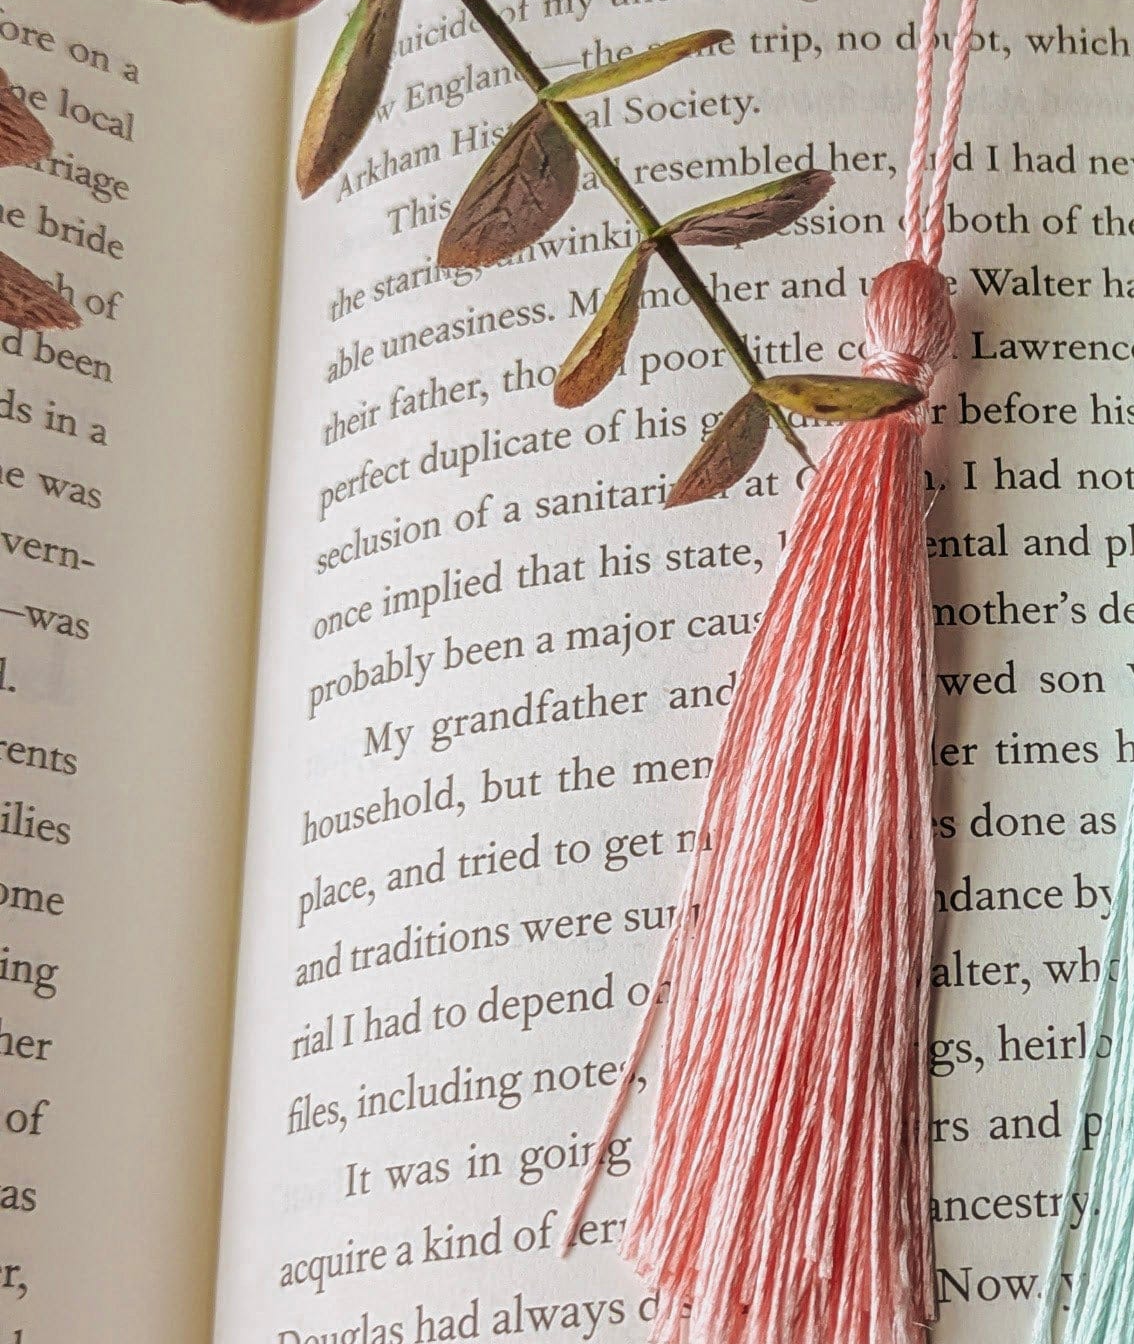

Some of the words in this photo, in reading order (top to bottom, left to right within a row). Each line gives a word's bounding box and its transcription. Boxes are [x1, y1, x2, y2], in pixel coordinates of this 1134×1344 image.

[66, 44, 109, 72] on
[750, 31, 822, 63] trip,
[837, 30, 881, 51] no
[1025, 24, 1131, 57] which
[59, 88, 134, 142] local
[333, 134, 441, 203] Arkham
[622, 88, 760, 125] Society.
[36, 205, 124, 260] bride
[386, 194, 452, 237] This
[634, 142, 816, 185] resembled
[829, 145, 896, 181] her,
[1012, 140, 1077, 174] had
[82, 291, 124, 320] of
[329, 288, 365, 322] the
[946, 202, 1030, 234] both
[1043, 203, 1082, 235] of
[35, 331, 113, 383] been
[326, 340, 374, 384] able
[380, 303, 555, 364] uneasiness.
[780, 265, 847, 300] and
[969, 264, 1092, 297] Walter
[44, 401, 77, 437] in
[323, 401, 381, 446] their
[390, 376, 489, 420] father,
[639, 344, 729, 386] poor
[37, 473, 101, 509] was
[319, 457, 410, 523] perfect
[419, 428, 571, 478] duplicate
[582, 417, 621, 445] of
[635, 407, 687, 440] his
[957, 391, 1077, 427] before
[316, 512, 442, 575] seclusion
[453, 503, 489, 532] of
[745, 467, 779, 497] at
[993, 456, 1062, 490] had
[313, 602, 372, 639] once
[381, 559, 503, 619] implied
[517, 553, 585, 589] that
[599, 543, 651, 578] his
[666, 543, 763, 574] state,
[1024, 523, 1091, 556] and
[308, 644, 436, 720] probably
[441, 636, 525, 670] been
[565, 612, 675, 658] major
[364, 721, 415, 761] My
[431, 683, 648, 753] grandfather
[1040, 671, 1106, 693] son
[303, 773, 465, 846] household,
[480, 768, 542, 803] but
[555, 755, 616, 793] the
[995, 732, 1099, 765] times
[298, 875, 375, 929] place,
[387, 846, 445, 891] and
[457, 832, 541, 878] tried
[554, 840, 591, 865] to
[601, 830, 664, 872] get
[970, 801, 1066, 837] done
[296, 940, 342, 987] and
[350, 921, 510, 972] traditions
[519, 911, 612, 944] were
[292, 1014, 334, 1060] rial
[363, 996, 422, 1043] had
[432, 1003, 467, 1030] to
[477, 971, 615, 1032] depend
[287, 1093, 347, 1135] files,
[357, 1065, 523, 1119] including
[346, 1163, 371, 1197] It
[385, 1159, 450, 1189] was
[990, 1099, 1062, 1140] and
[280, 1239, 387, 1295] acquire
[422, 1215, 502, 1263] kind
[512, 1209, 558, 1252] of
[414, 1298, 480, 1344] had
[492, 1293, 625, 1341] always
